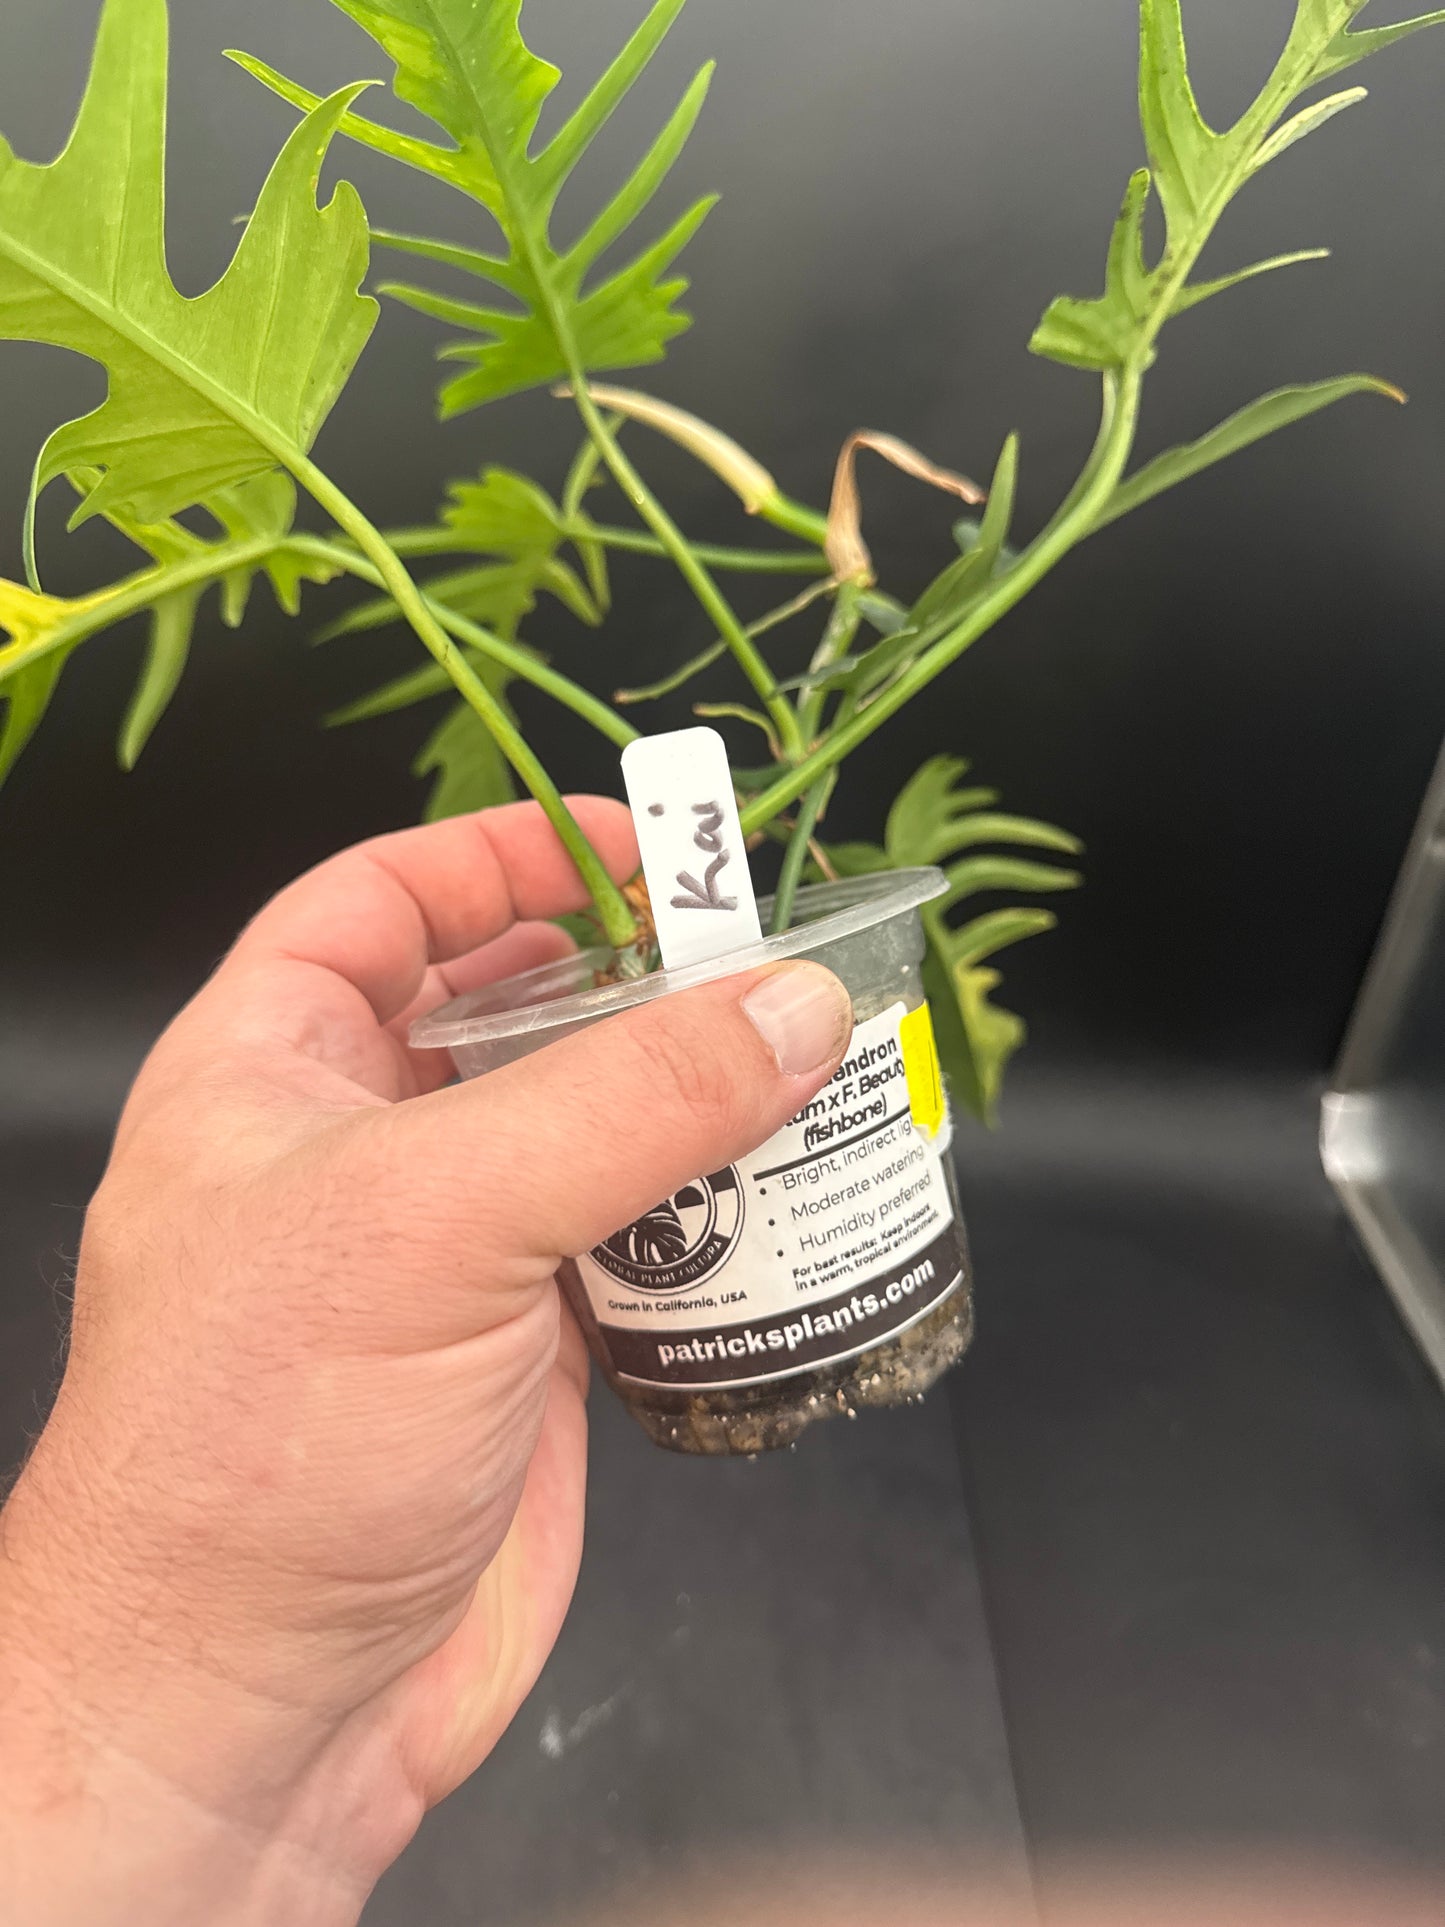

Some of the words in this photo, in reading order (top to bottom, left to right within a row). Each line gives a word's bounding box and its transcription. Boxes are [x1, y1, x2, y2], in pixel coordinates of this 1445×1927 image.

[648, 800, 738, 911] Kai
[824, 1037, 898, 1087] endron
[786, 1099, 826, 1126] um
[828, 1092, 841, 1111] x
[842, 1081, 858, 1105] F.
[804, 1092, 887, 1152] (fishbone)
[782, 1158, 842, 1190] Bright,
[842, 1127, 897, 1166] indirect
[897, 1114, 913, 1136] lig
[791, 1179, 871, 1221] Moderate
[872, 1144, 925, 1186] watering
[800, 1209, 876, 1251] Humidity
[878, 1169, 932, 1221] preferred
[641, 1271, 676, 1285] PLANT
[792, 1265, 811, 1278] For
[814, 1255, 838, 1271] best
[840, 1237, 878, 1260] results:
[880, 1223, 903, 1241] Keep
[810, 1278, 818, 1287] a
[819, 1265, 854, 1283] warm,
[854, 1243, 892, 1267] tropical
[608, 1299, 640, 1312] Grown
[655, 1296, 718, 1313] California,
[720, 1289, 748, 1305] USA
[657, 1258, 937, 1369] patricksplants.com
